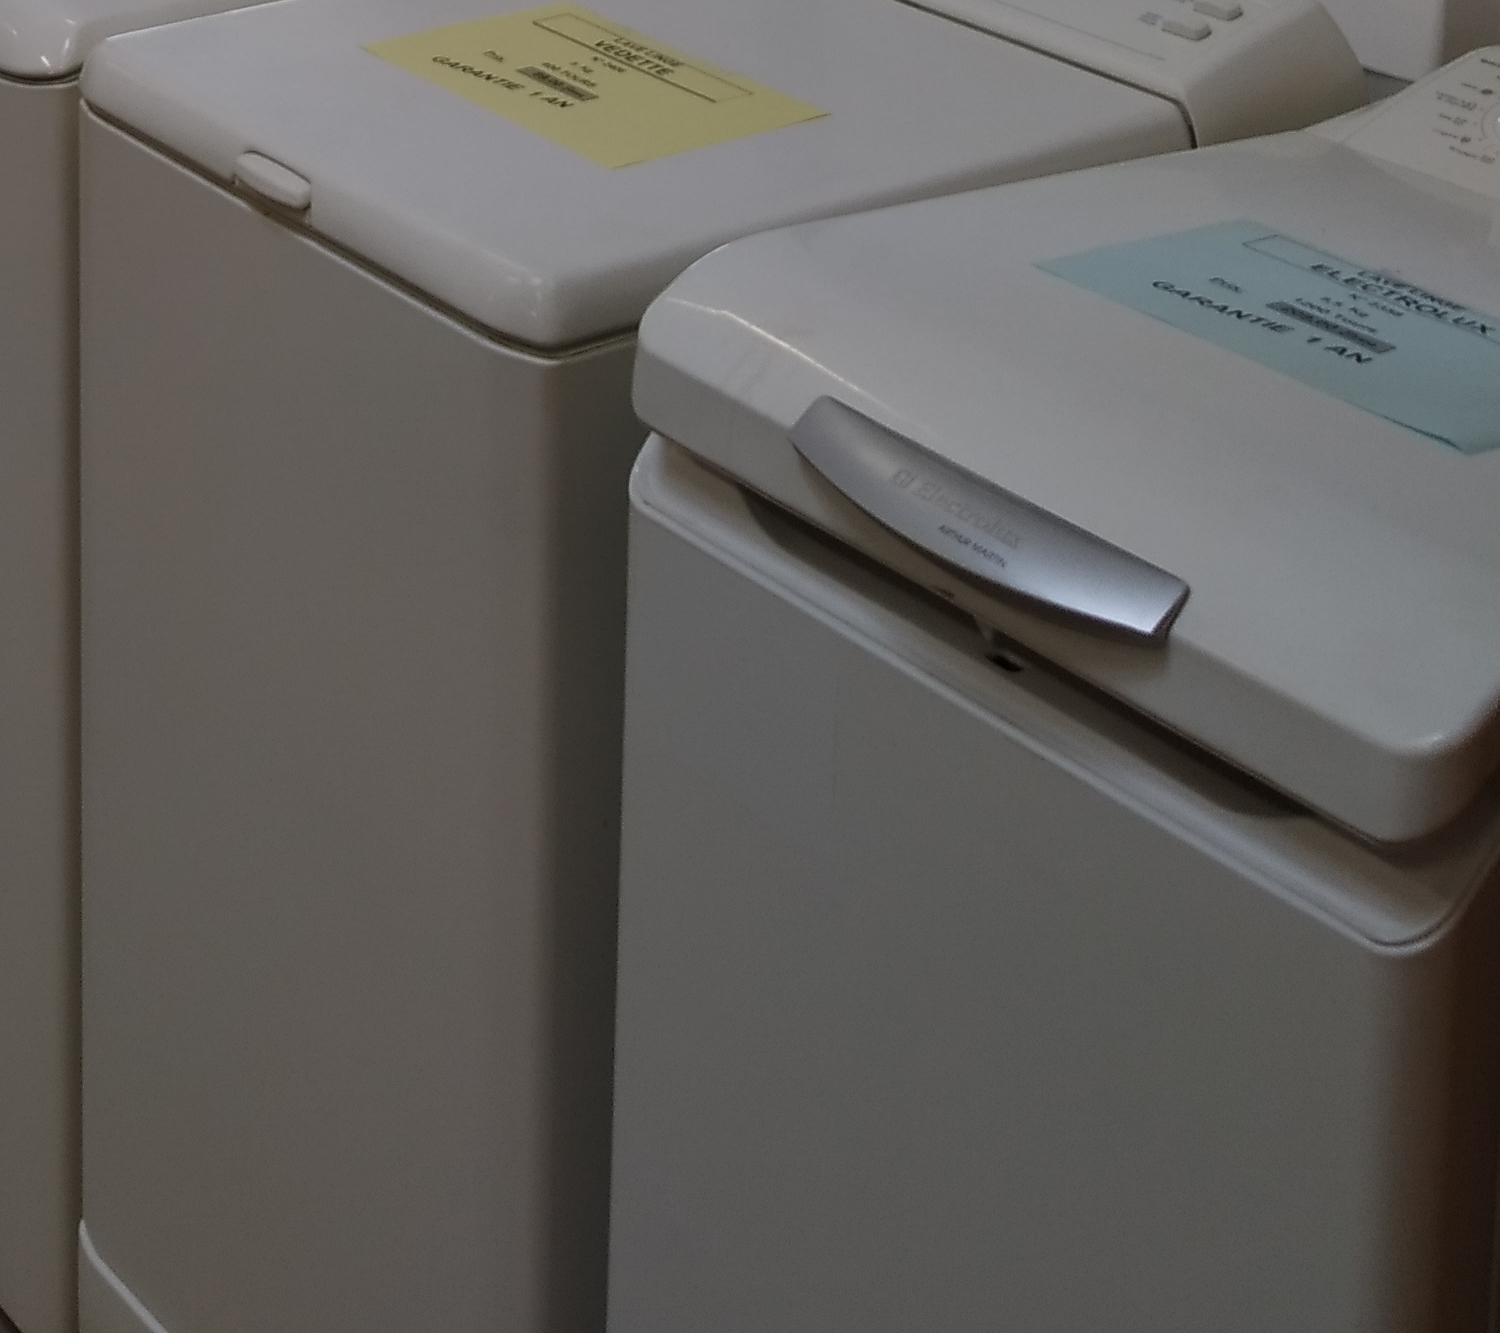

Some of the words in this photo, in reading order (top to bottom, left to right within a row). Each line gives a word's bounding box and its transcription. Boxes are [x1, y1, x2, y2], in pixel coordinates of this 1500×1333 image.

[431, 55, 526, 91] GARANTIE
[539, 96, 575, 108] AN
[594, 39, 675, 75] VEDETTE
[1151, 280, 1296, 333] GARANTIE
[1323, 345, 1373, 364] AN
[1310, 263, 1497, 334] ELECTROLUX
